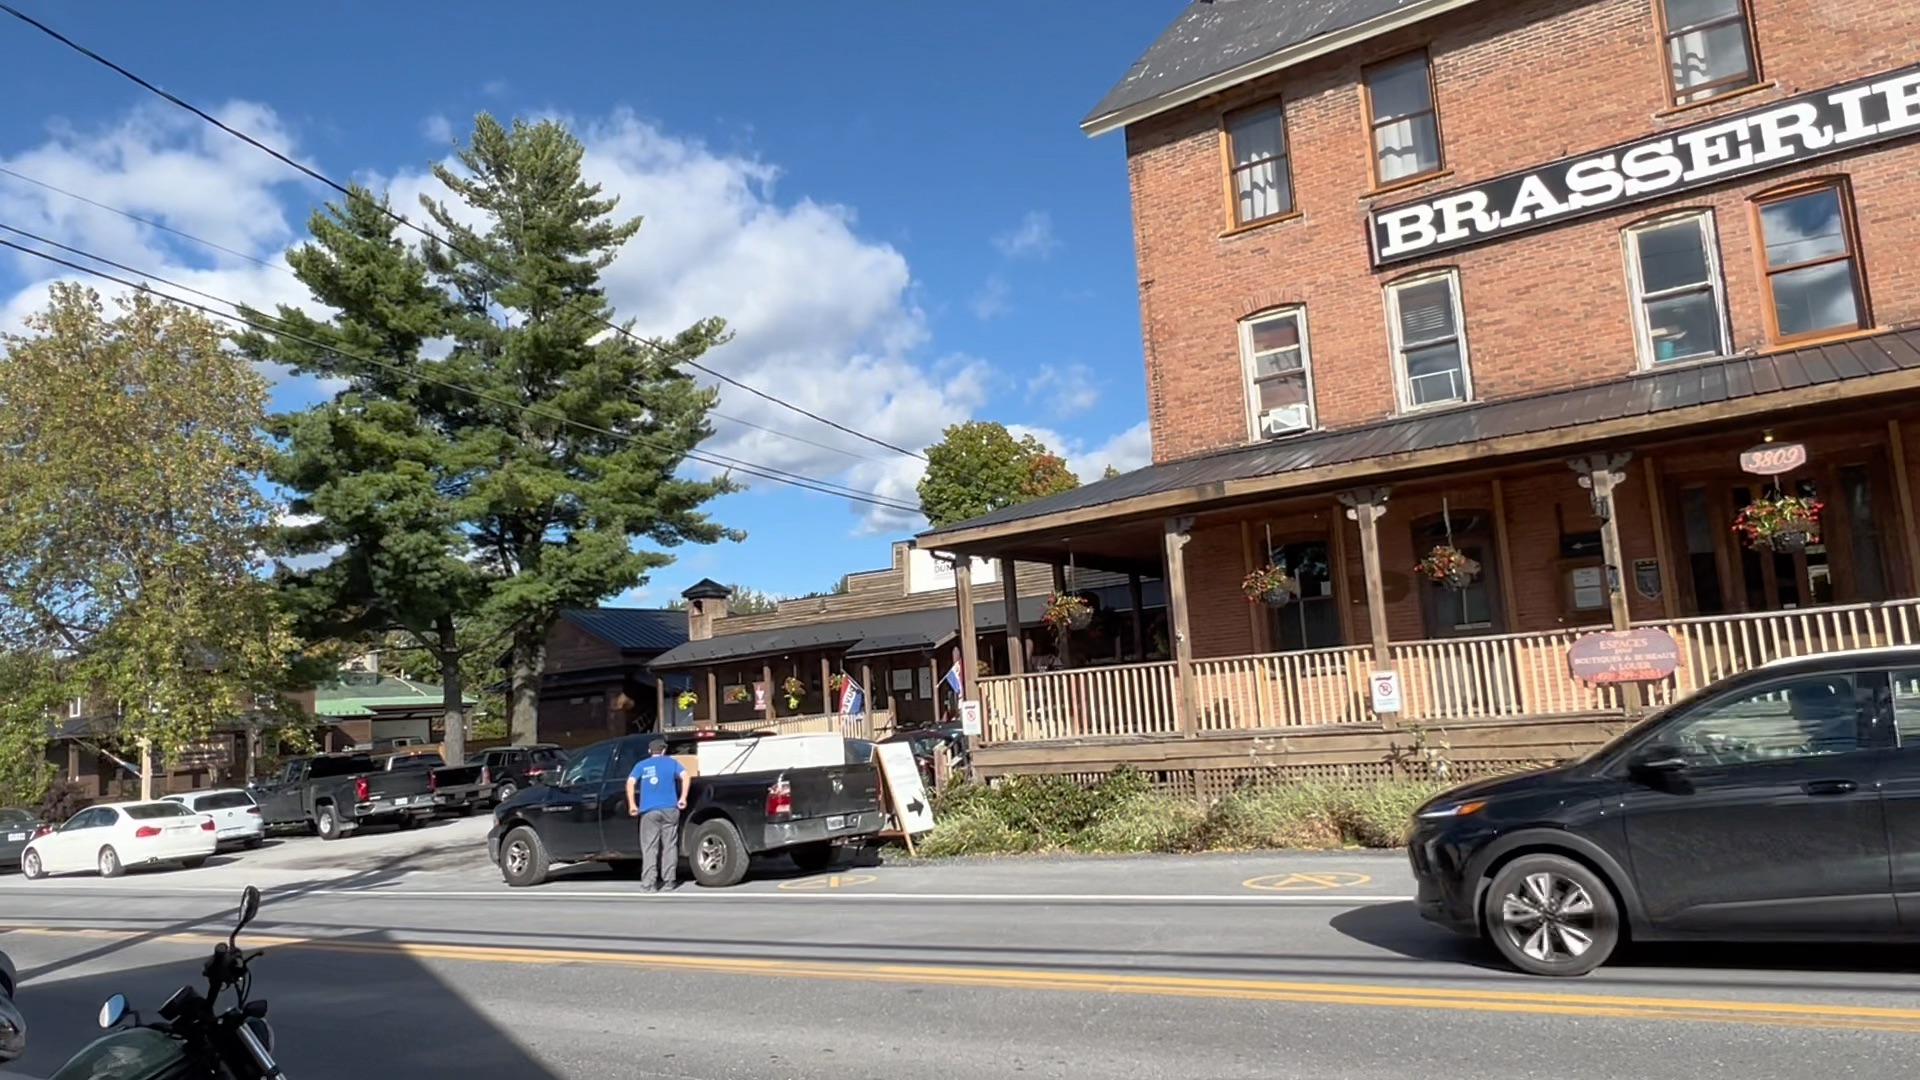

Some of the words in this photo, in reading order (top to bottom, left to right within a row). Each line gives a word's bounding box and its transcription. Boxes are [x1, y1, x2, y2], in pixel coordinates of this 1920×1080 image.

[1377, 72, 1920, 257] BRASSERIE
[1749, 448, 1798, 468] 3809
[1599, 638, 1648, 650] ESPACES
[1619, 661, 1652, 671] LOUER
